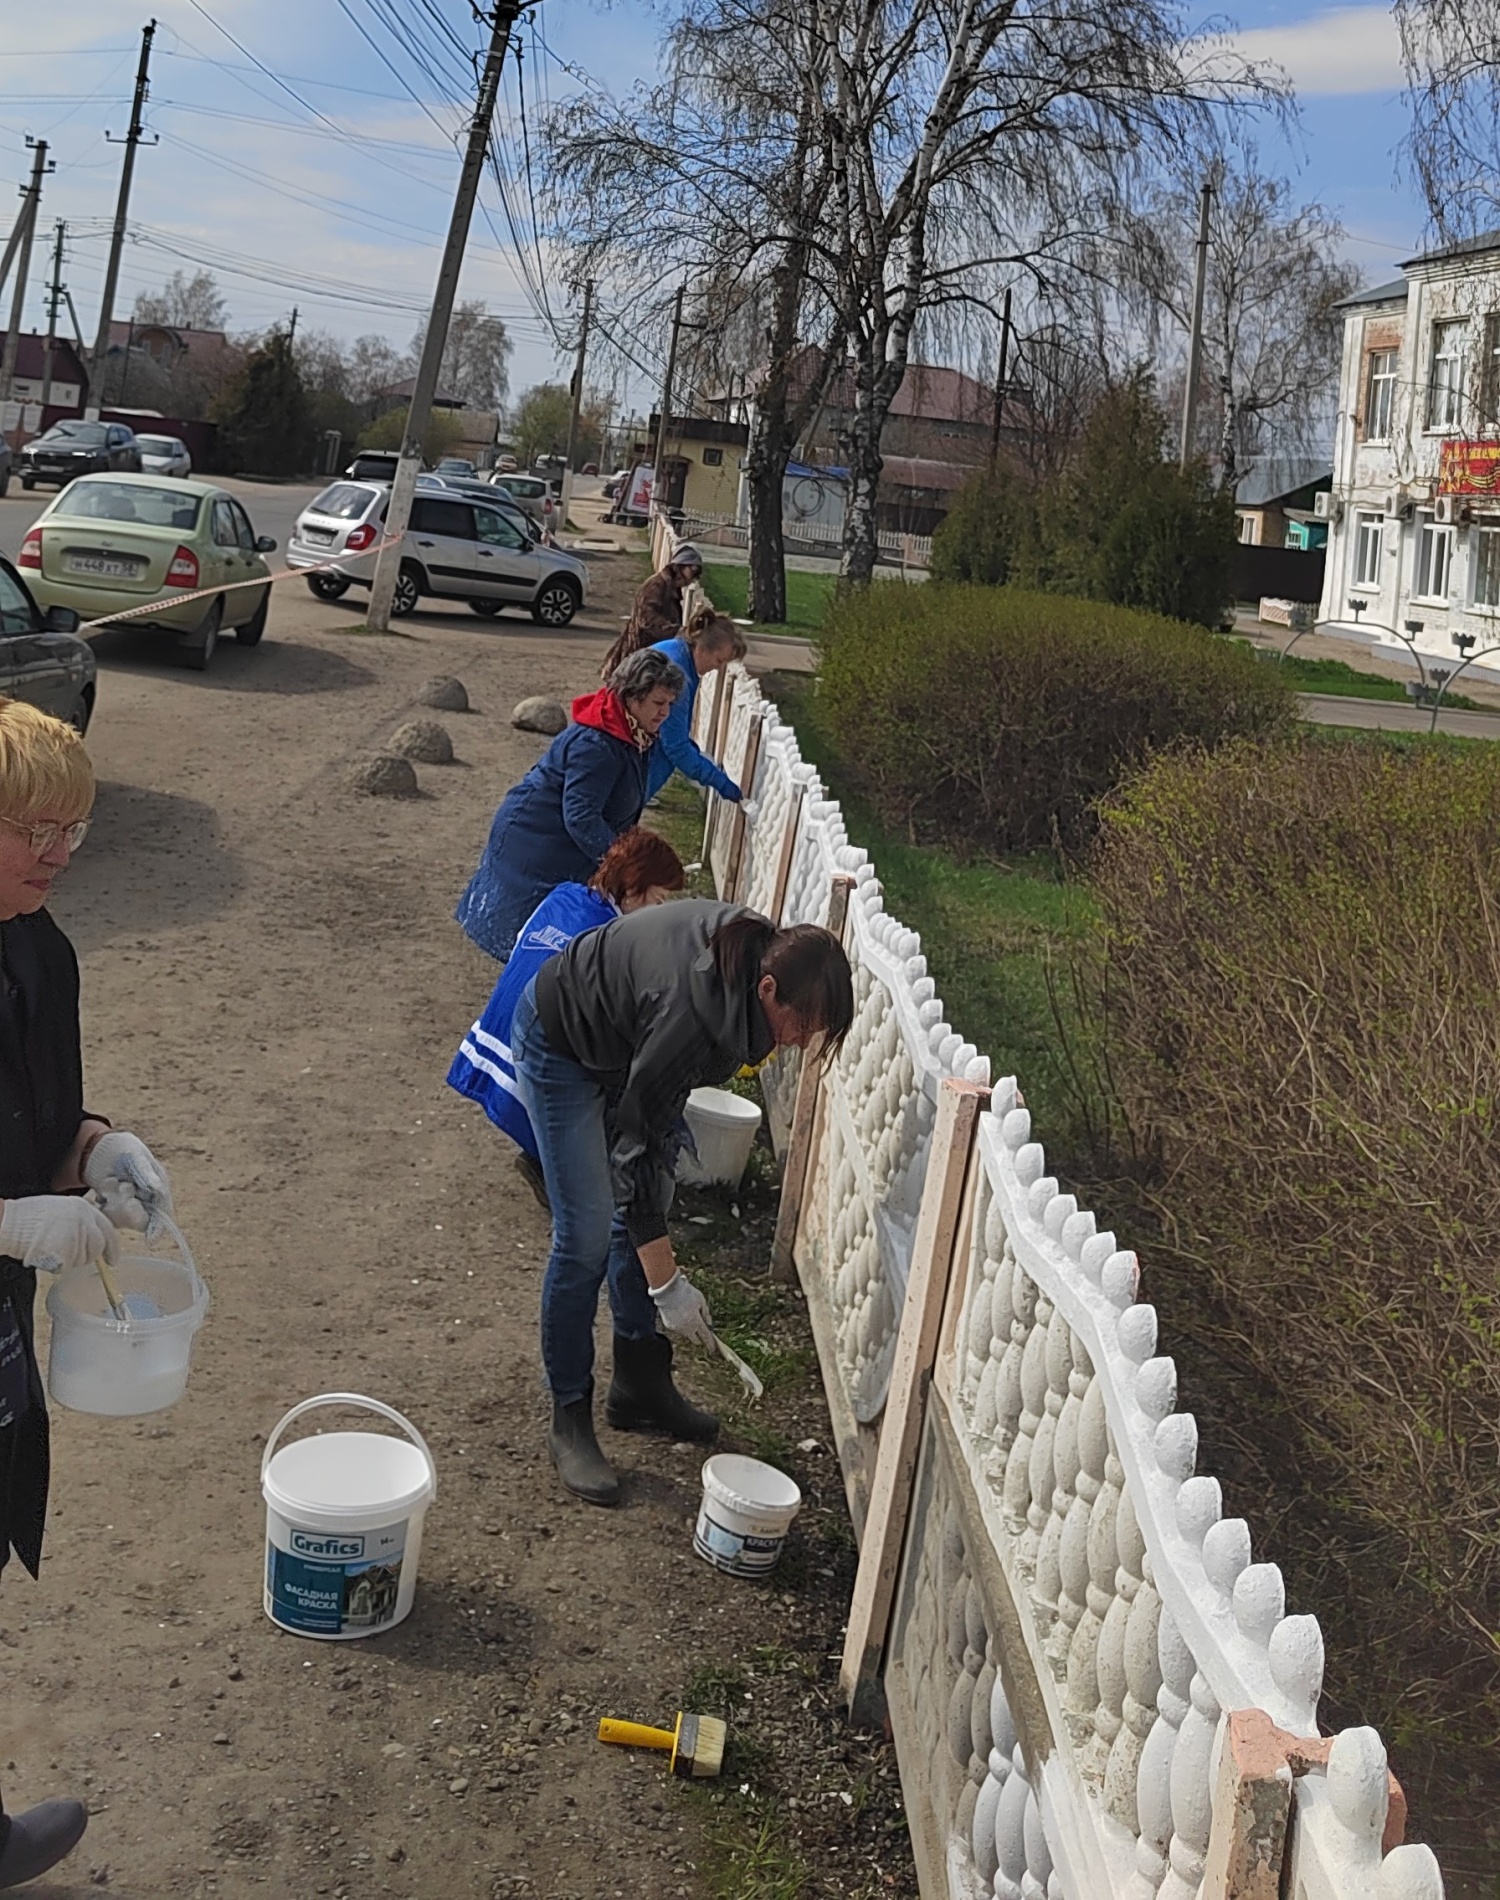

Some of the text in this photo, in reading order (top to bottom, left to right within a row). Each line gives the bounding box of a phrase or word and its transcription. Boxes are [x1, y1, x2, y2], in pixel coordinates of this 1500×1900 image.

[294, 1535, 360, 1555] Grafics
[284, 1583, 338, 1600] ФАСАДНАЯ
[298, 1597, 338, 1610] КРАСКА
